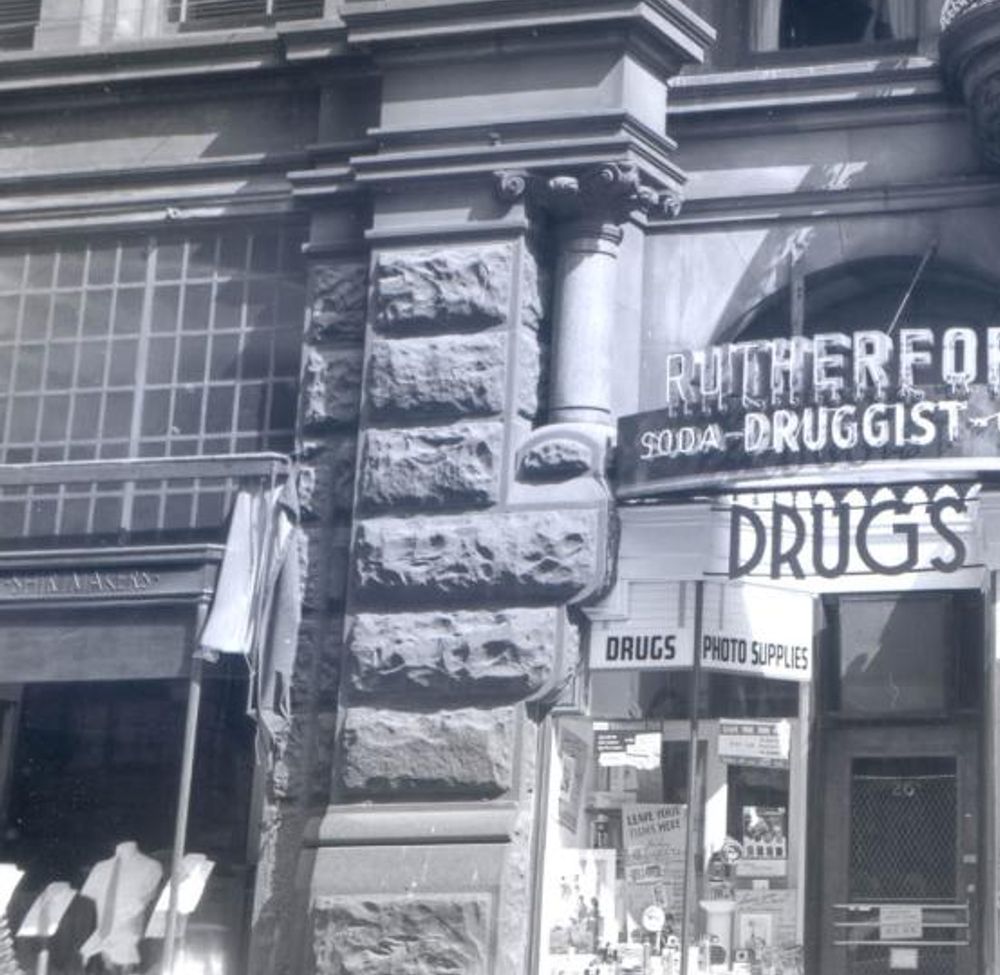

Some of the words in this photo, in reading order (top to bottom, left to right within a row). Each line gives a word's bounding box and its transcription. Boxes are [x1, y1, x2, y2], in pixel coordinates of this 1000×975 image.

[640, 424, 725, 460] SODA
[744, 401, 968, 454] DRUGGIST
[729, 497, 967, 580] DRUGS
[605, 635, 677, 662] DRUGS
[702, 635, 747, 666] PHOTO
[751, 639, 809, 672] SUPPLIES
